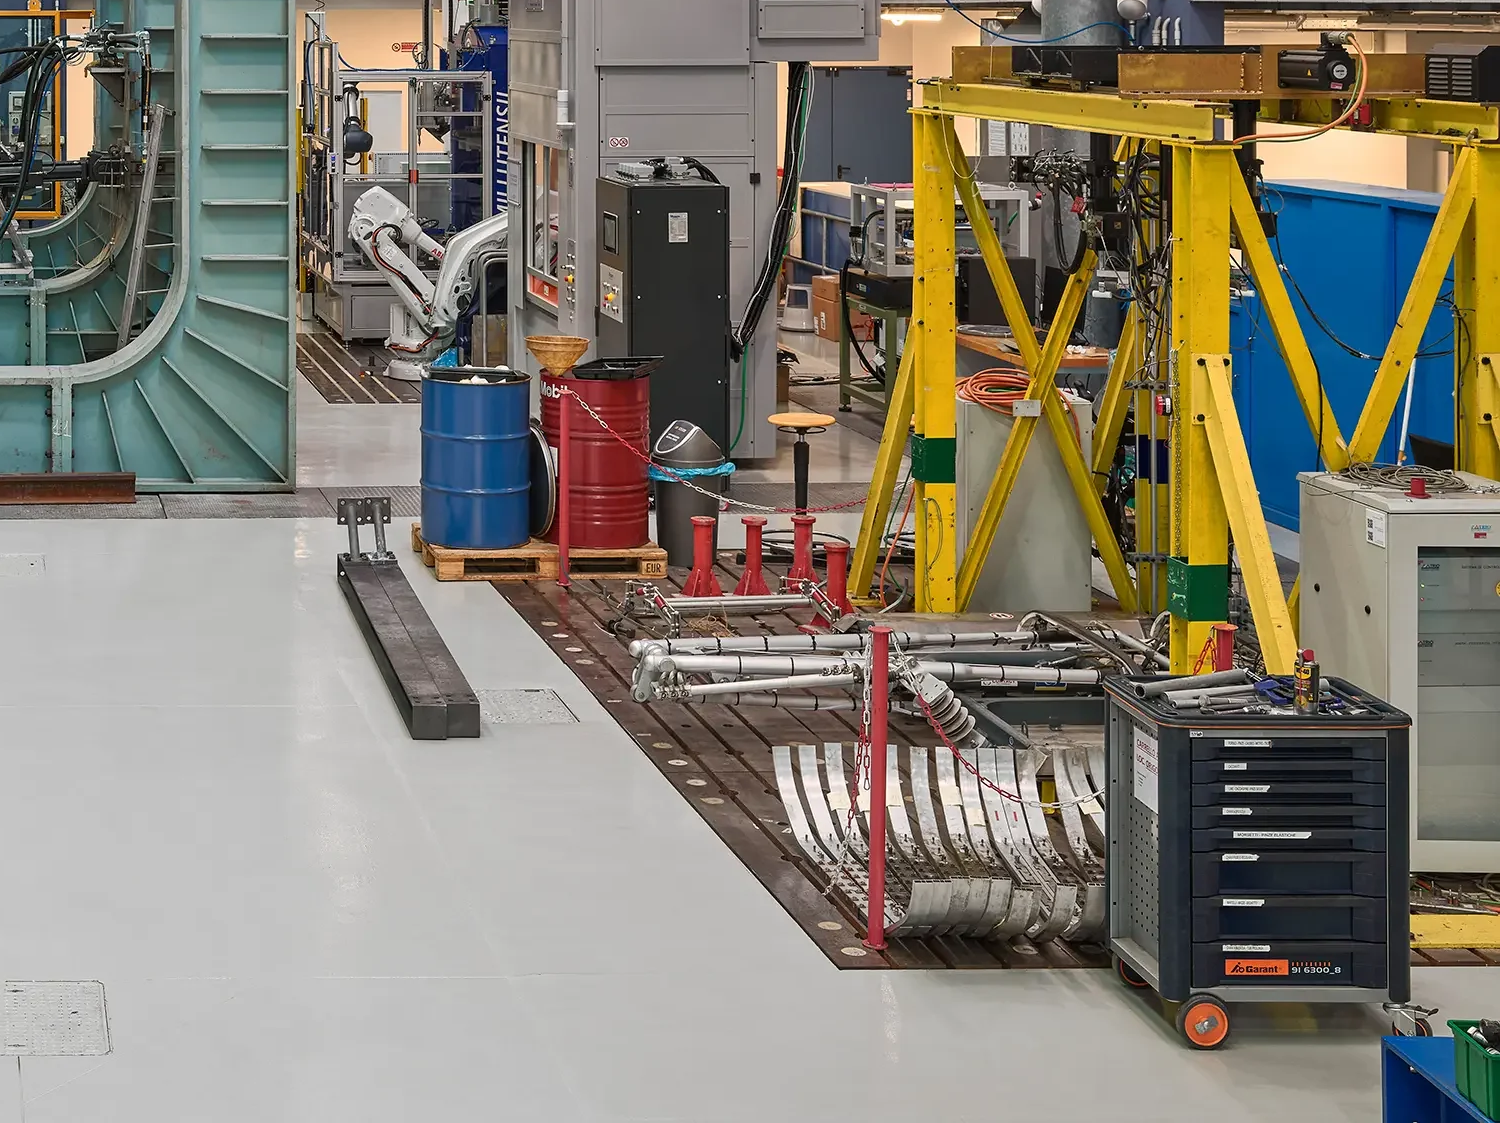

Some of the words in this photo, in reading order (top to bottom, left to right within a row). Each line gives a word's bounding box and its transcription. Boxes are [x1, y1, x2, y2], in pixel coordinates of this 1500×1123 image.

[646, 562, 661, 573] EUR
[1245, 965, 1279, 974] Garant
[1303, 966, 1342, 975] 6300_8
